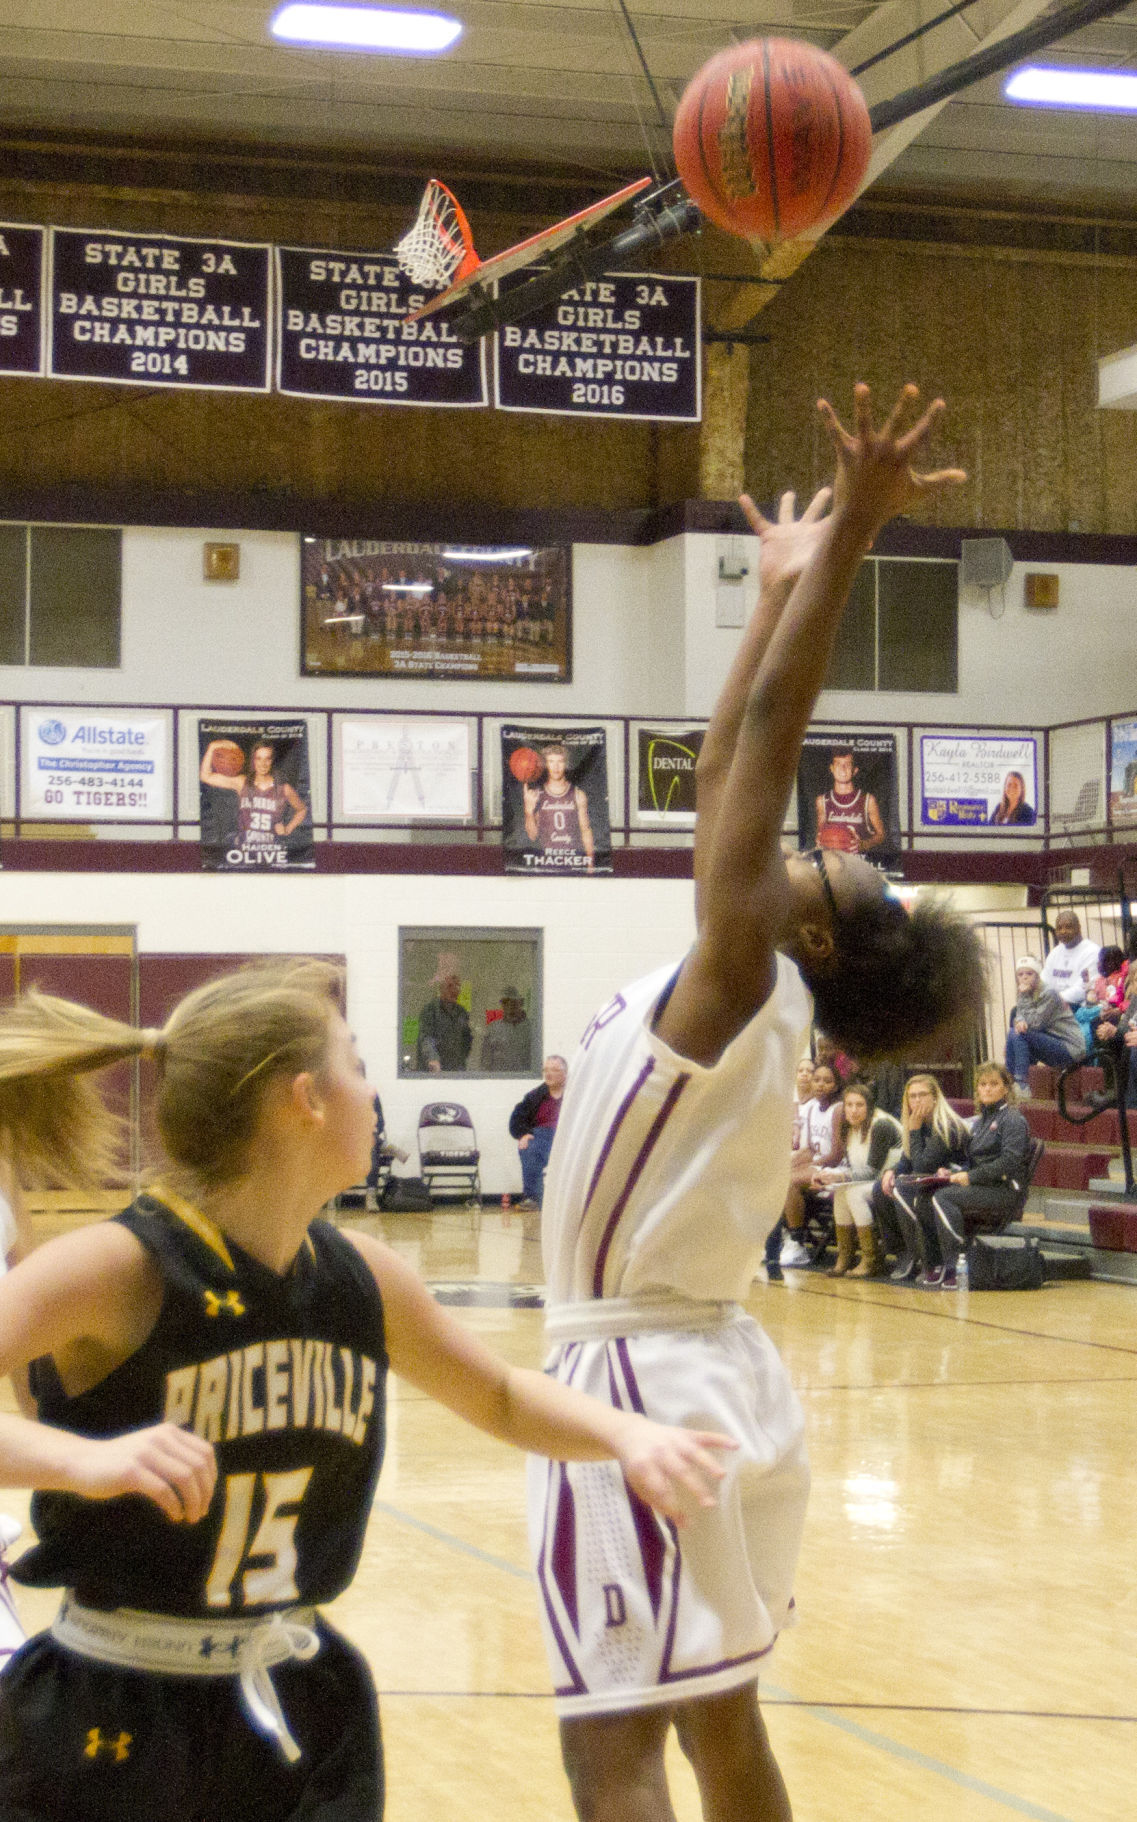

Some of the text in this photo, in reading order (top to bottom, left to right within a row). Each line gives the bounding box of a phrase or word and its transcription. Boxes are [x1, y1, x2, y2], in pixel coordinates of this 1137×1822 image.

[84, 243, 238, 275] STATE 3A
[116, 271, 206, 298] GIRLS
[309, 260, 400, 287] STATE
[339, 289, 425, 314] GIRLS
[559, 281, 669, 306] ATE 3A
[59, 293, 260, 328] BASKETBALL
[557, 306, 641, 330] GIRLS
[73, 321, 246, 353] CHAMPIONS
[286, 309, 461, 343] BASKETBAL
[299, 338, 464, 369] CHAMPIONS
[503, 326, 691, 358] BASKETBALL
[130, 351, 189, 375] 2014
[517, 353, 679, 383] CHAMPIONS
[354, 369, 409, 392] 2015
[571, 383, 626, 406] 2016
[71, 725, 146, 745] Allstate
[802, 738, 893, 747] AUDERDALE COUNTY
[653, 757, 694, 770] DENTAL
[925, 742, 1031, 763] Kayla Birdwell
[48, 775, 144, 788] 256-483-4144
[44, 789, 148, 807] GO TIGERS!!
[250, 812, 272, 831] 35
[226, 849, 288, 864] OLIVE
[523, 854, 593, 866] THACKER
[164, 1338, 377, 1445] PRICEVILLE
[206, 1466, 314, 1607] 15
